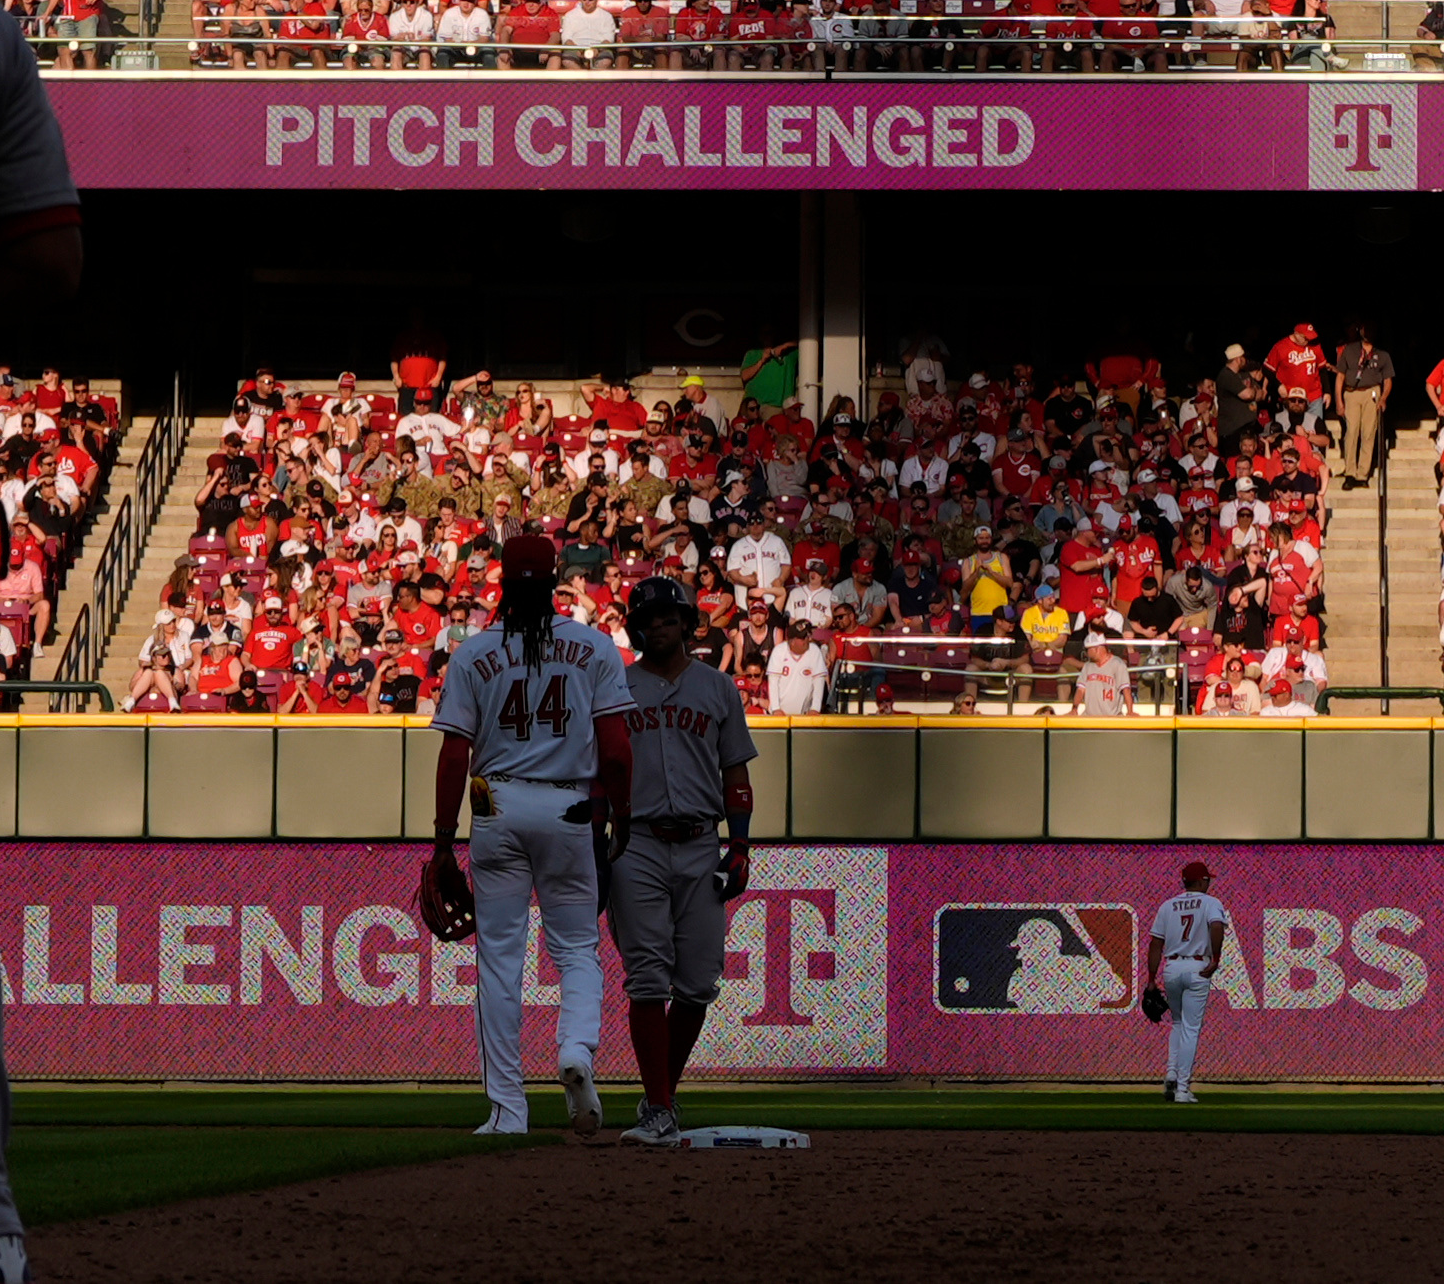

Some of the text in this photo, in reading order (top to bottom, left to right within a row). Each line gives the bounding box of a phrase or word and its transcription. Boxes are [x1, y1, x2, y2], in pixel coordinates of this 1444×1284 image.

[267, 104, 1035, 169] PITCH CHALLENGED
[1288, 349, 1316, 364] Reds
[472, 639, 595, 683] DE L CRUZ
[499, 674, 571, 741] 44
[1102, 689, 1114, 701] 14
[626, 704, 712, 739] OSTON
[1180, 914, 1194, 942] 7
